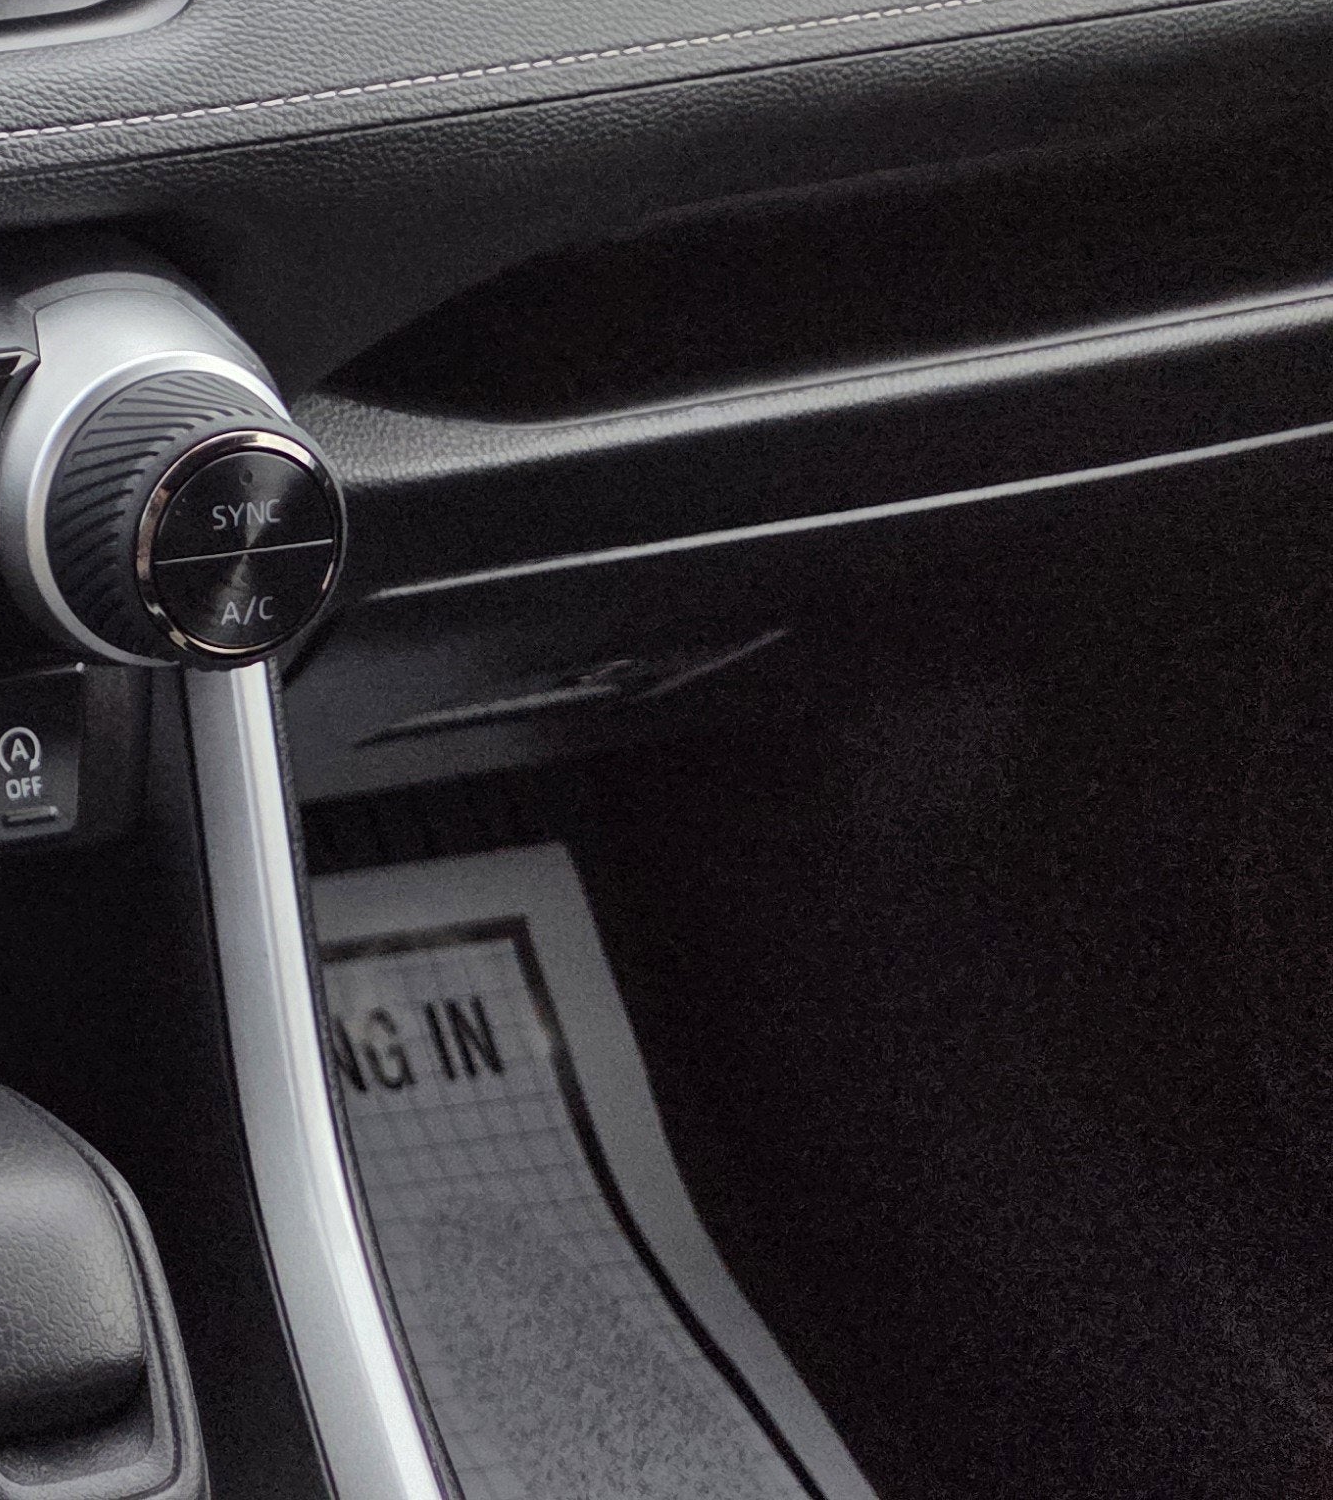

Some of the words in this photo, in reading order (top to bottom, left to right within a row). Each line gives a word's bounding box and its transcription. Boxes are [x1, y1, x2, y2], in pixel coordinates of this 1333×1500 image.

[211, 499, 282, 531] SYNC
[221, 595, 274, 627] A/C
[5, 774, 43, 800] OFF
[424, 998, 504, 1082] IN
